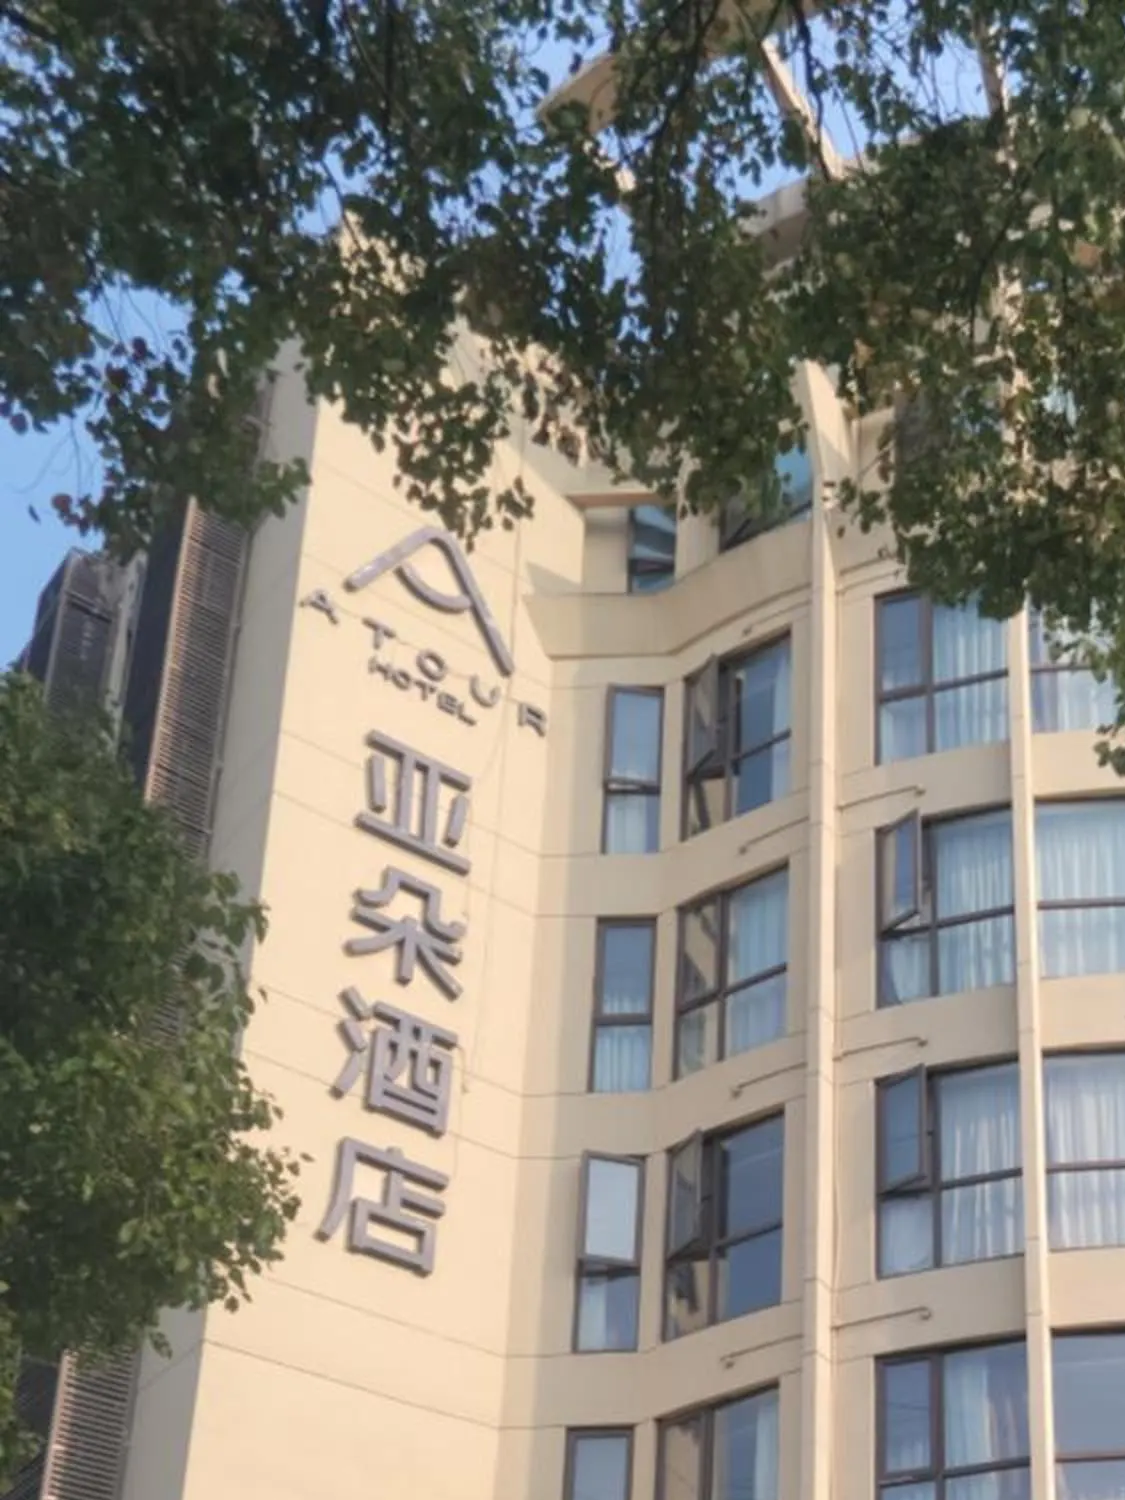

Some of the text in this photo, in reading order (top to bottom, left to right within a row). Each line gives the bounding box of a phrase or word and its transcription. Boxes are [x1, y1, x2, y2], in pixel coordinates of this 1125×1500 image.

[298, 587, 547, 739] ATOUR
[367, 655, 477, 728] HOTEL
[315, 728, 473, 1277] 亚朵酒店
